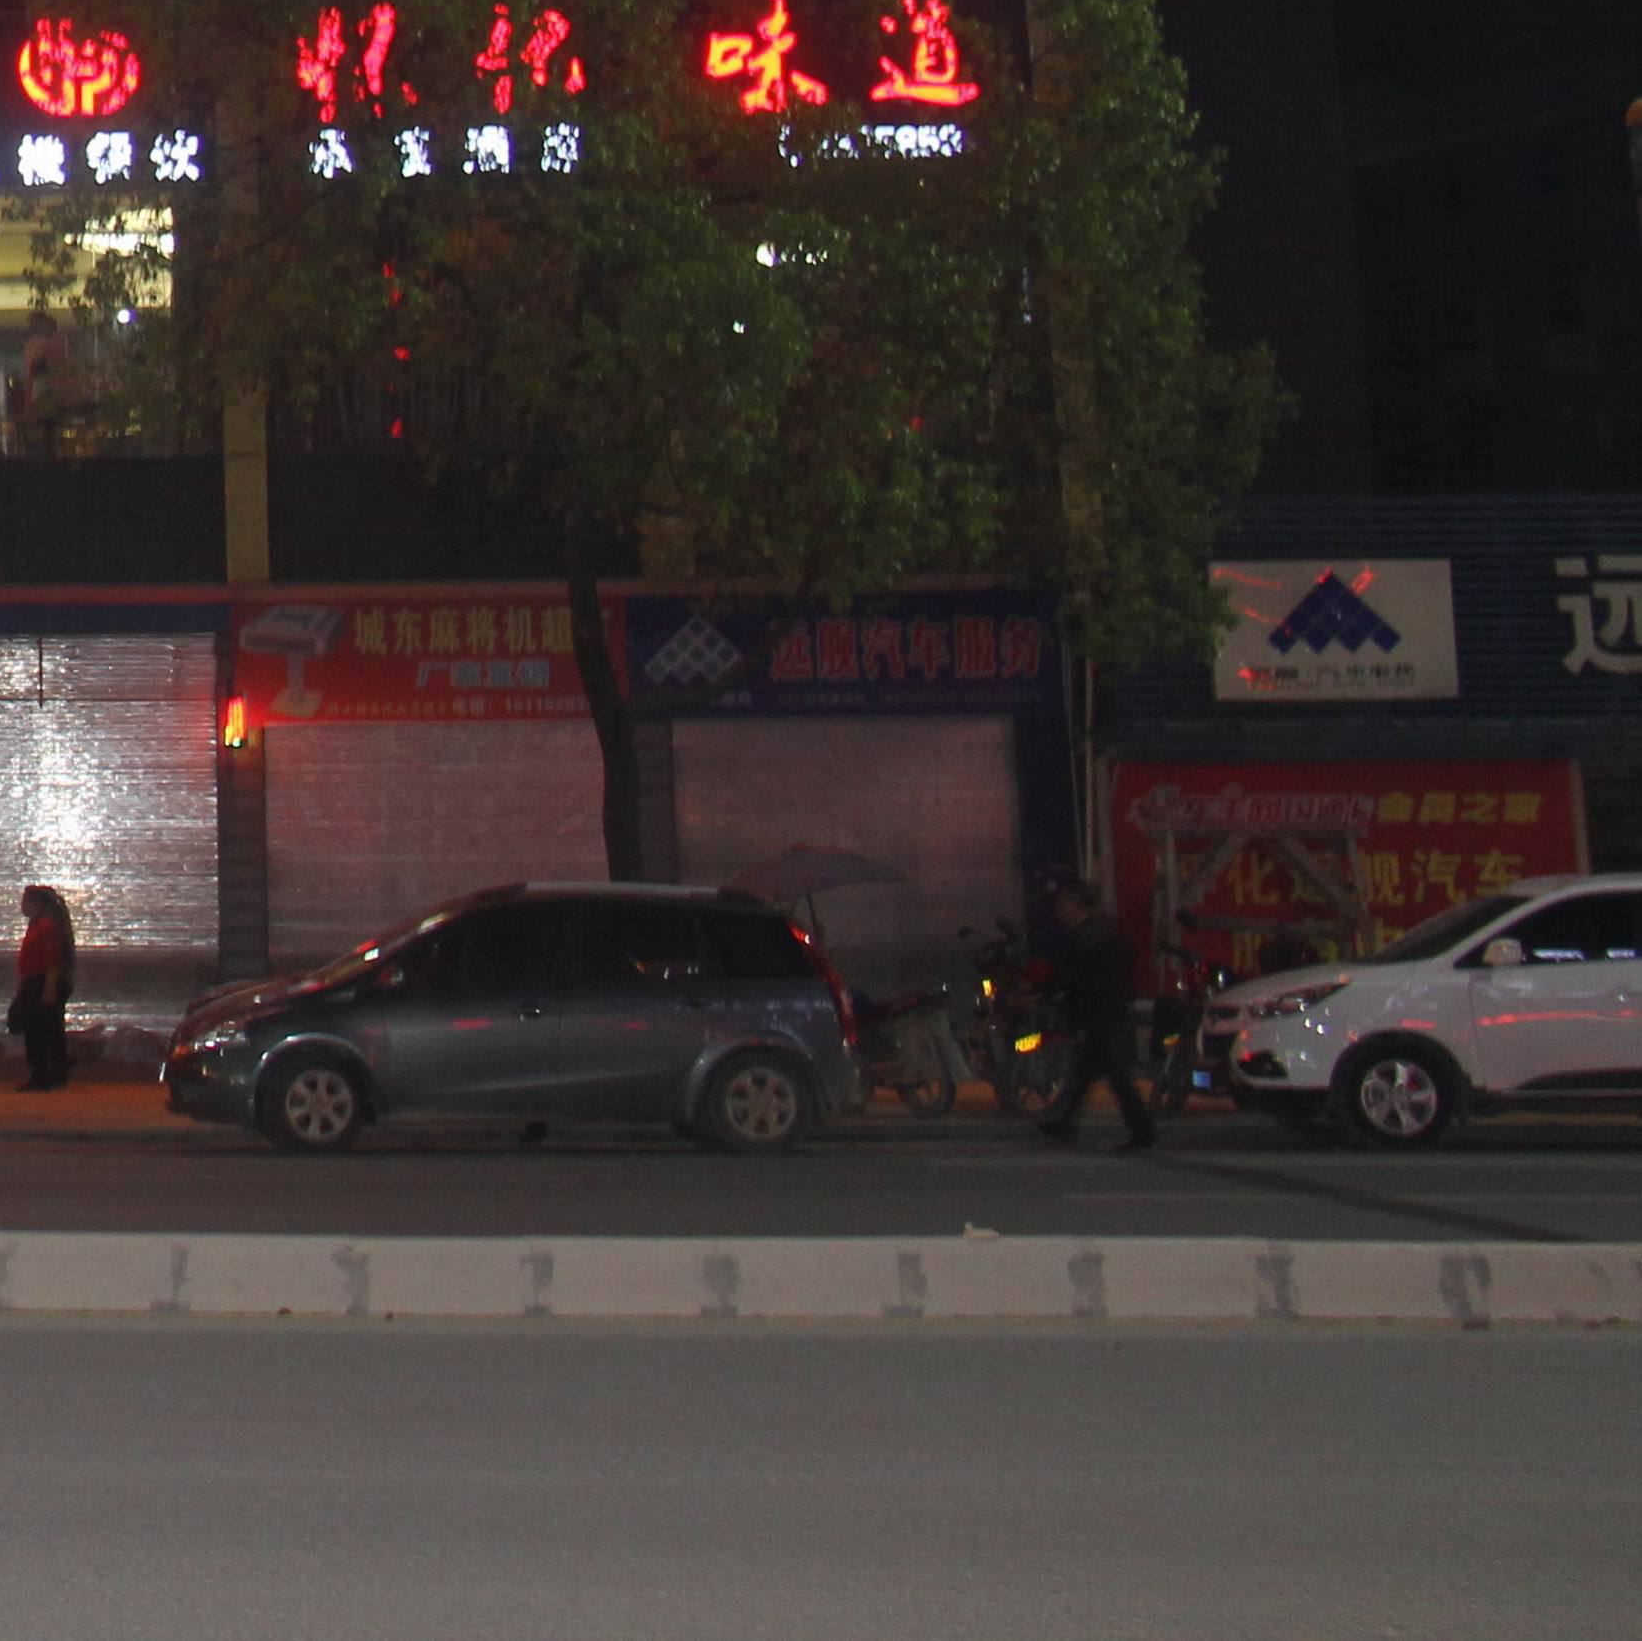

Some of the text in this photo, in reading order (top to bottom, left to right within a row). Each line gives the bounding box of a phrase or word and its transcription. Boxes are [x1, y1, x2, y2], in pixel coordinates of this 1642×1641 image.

[353, 604, 611, 659] 城东麻将机超
[769, 614, 1045, 682] 远舰汽车服务
